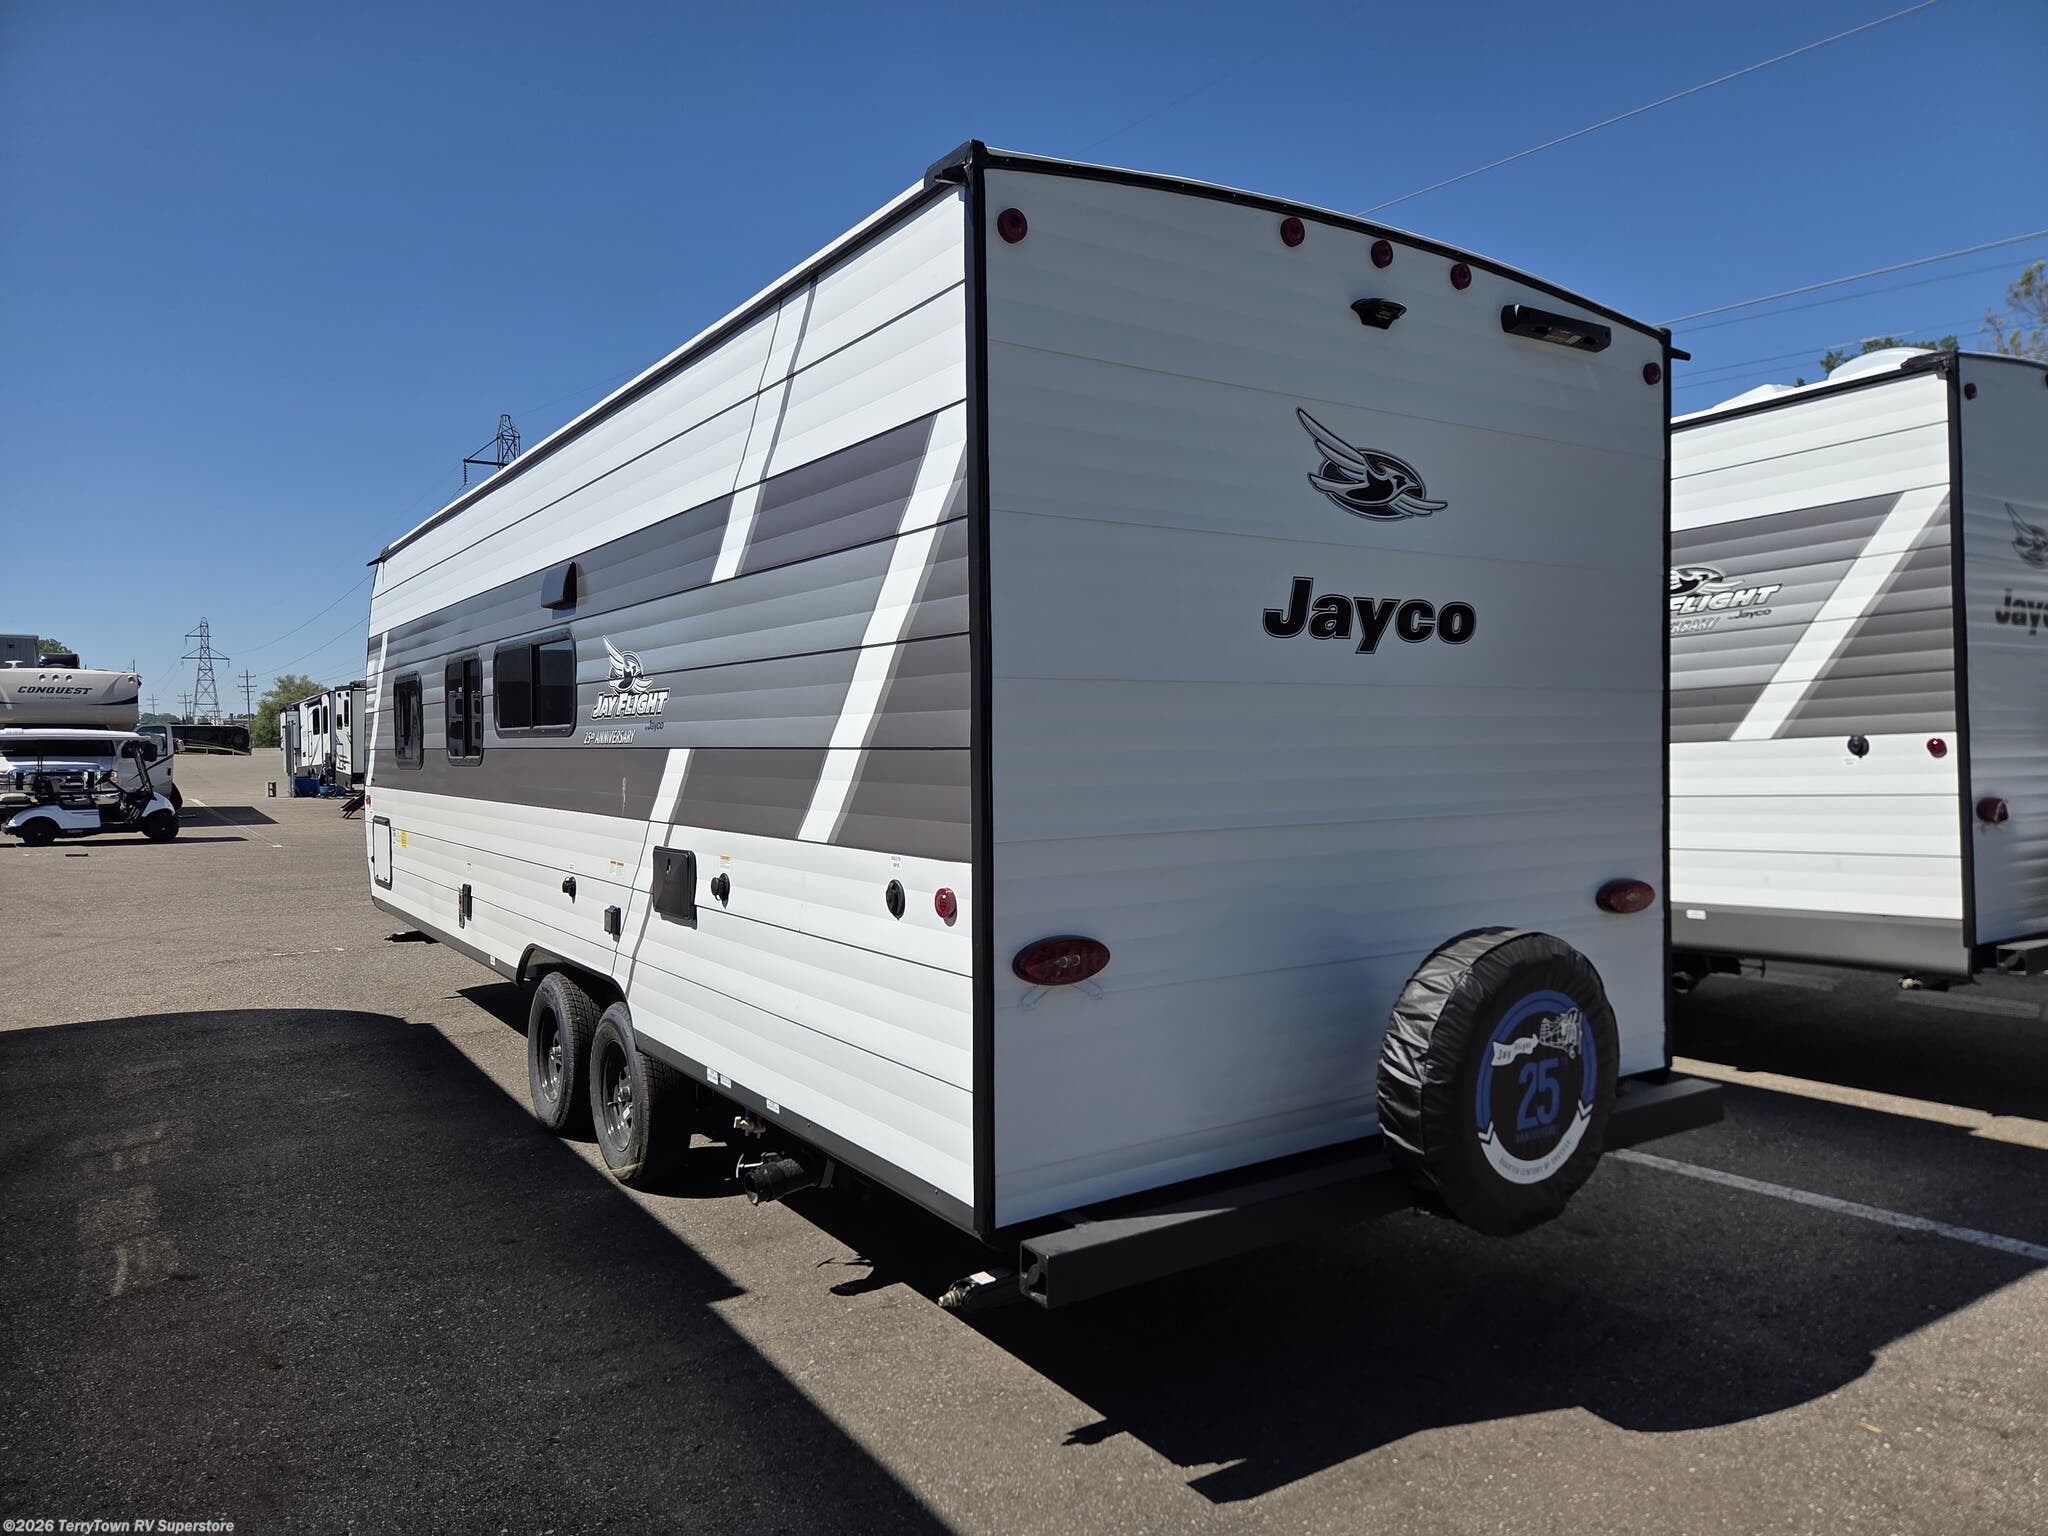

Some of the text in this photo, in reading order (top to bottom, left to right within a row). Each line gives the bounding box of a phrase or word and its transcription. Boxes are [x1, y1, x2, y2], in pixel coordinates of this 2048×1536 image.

[1262, 576, 1477, 654] Jayco
[17, 686, 93, 695] CONQUEST
[591, 688, 670, 720] JAY FLIGHT
[595, 729, 636, 744] ANNIVERSARY
